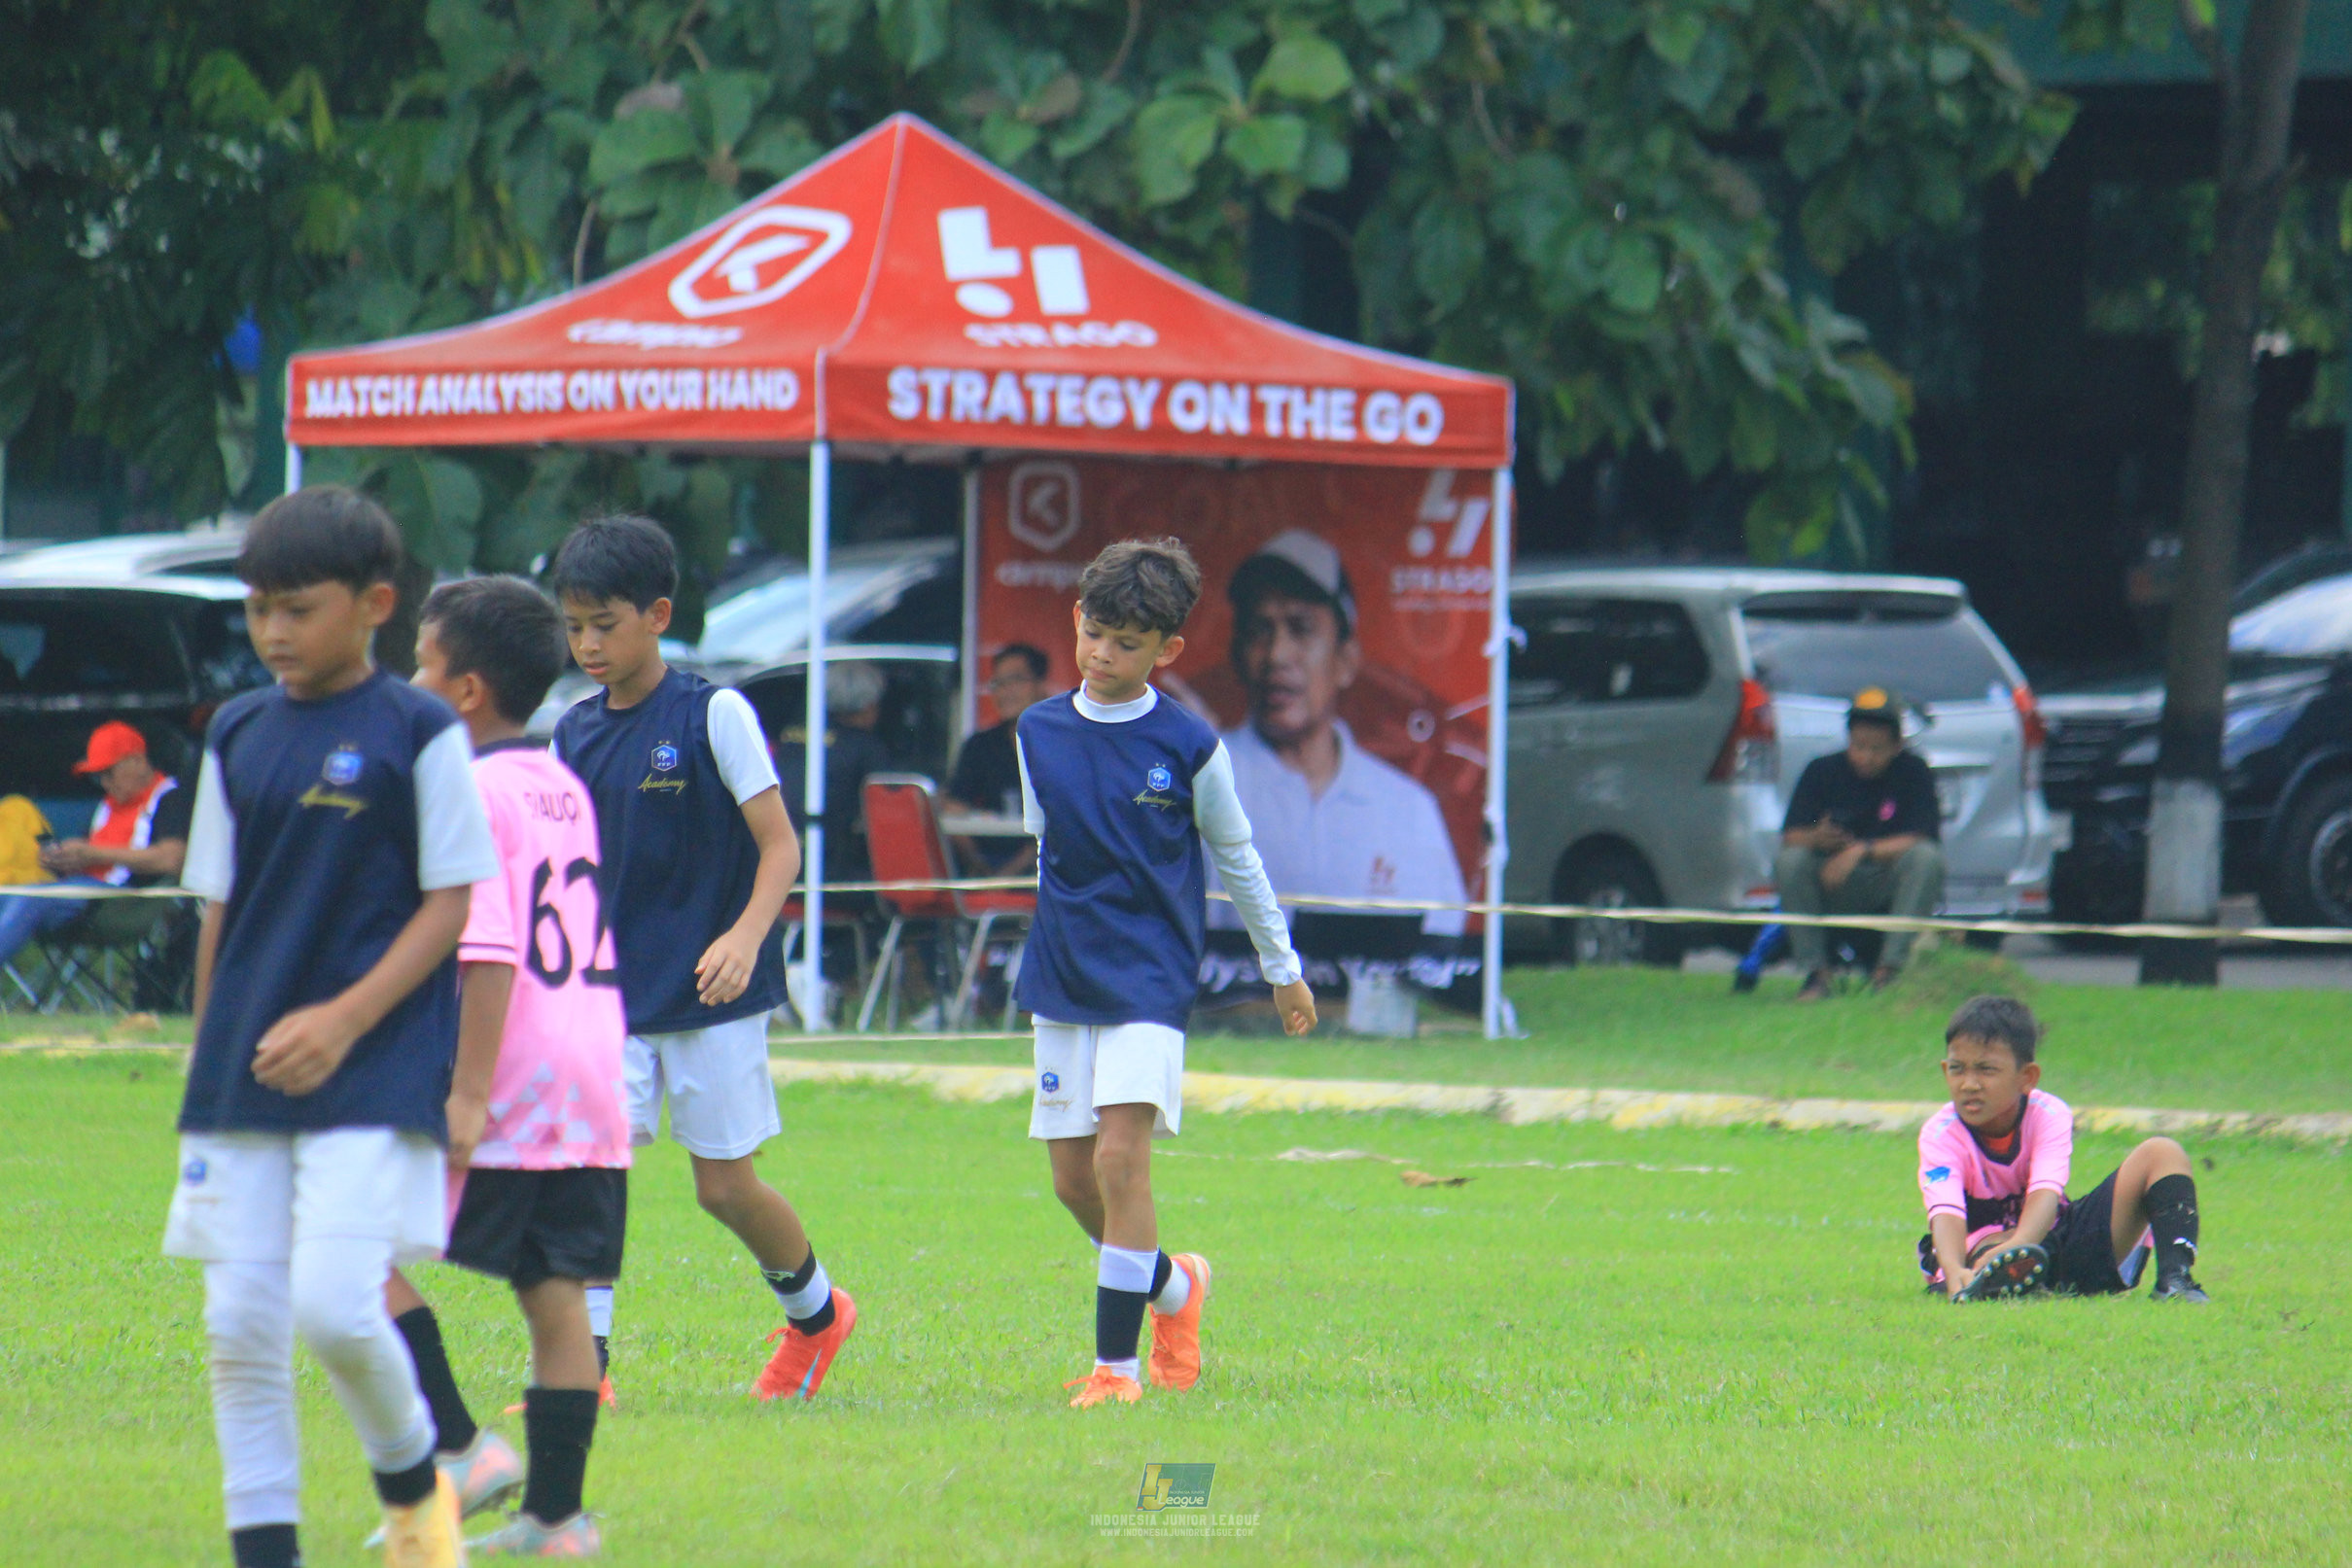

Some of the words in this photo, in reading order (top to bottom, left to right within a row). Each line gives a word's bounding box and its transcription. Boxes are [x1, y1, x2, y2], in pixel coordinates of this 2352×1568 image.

[305, 376, 416, 418] MATCH
[419, 370, 564, 416] ANALYSIS
[568, 369, 616, 412] ON
[618, 368, 703, 411] YOUR
[706, 367, 800, 410] HAND
[887, 366, 1162, 430] STRATEGY
[1167, 381, 1250, 436] ON
[1255, 385, 1358, 442] THE
[1362, 391, 1445, 446] GO
[638, 773, 686, 795] Academy
[525, 855, 619, 990] 62
